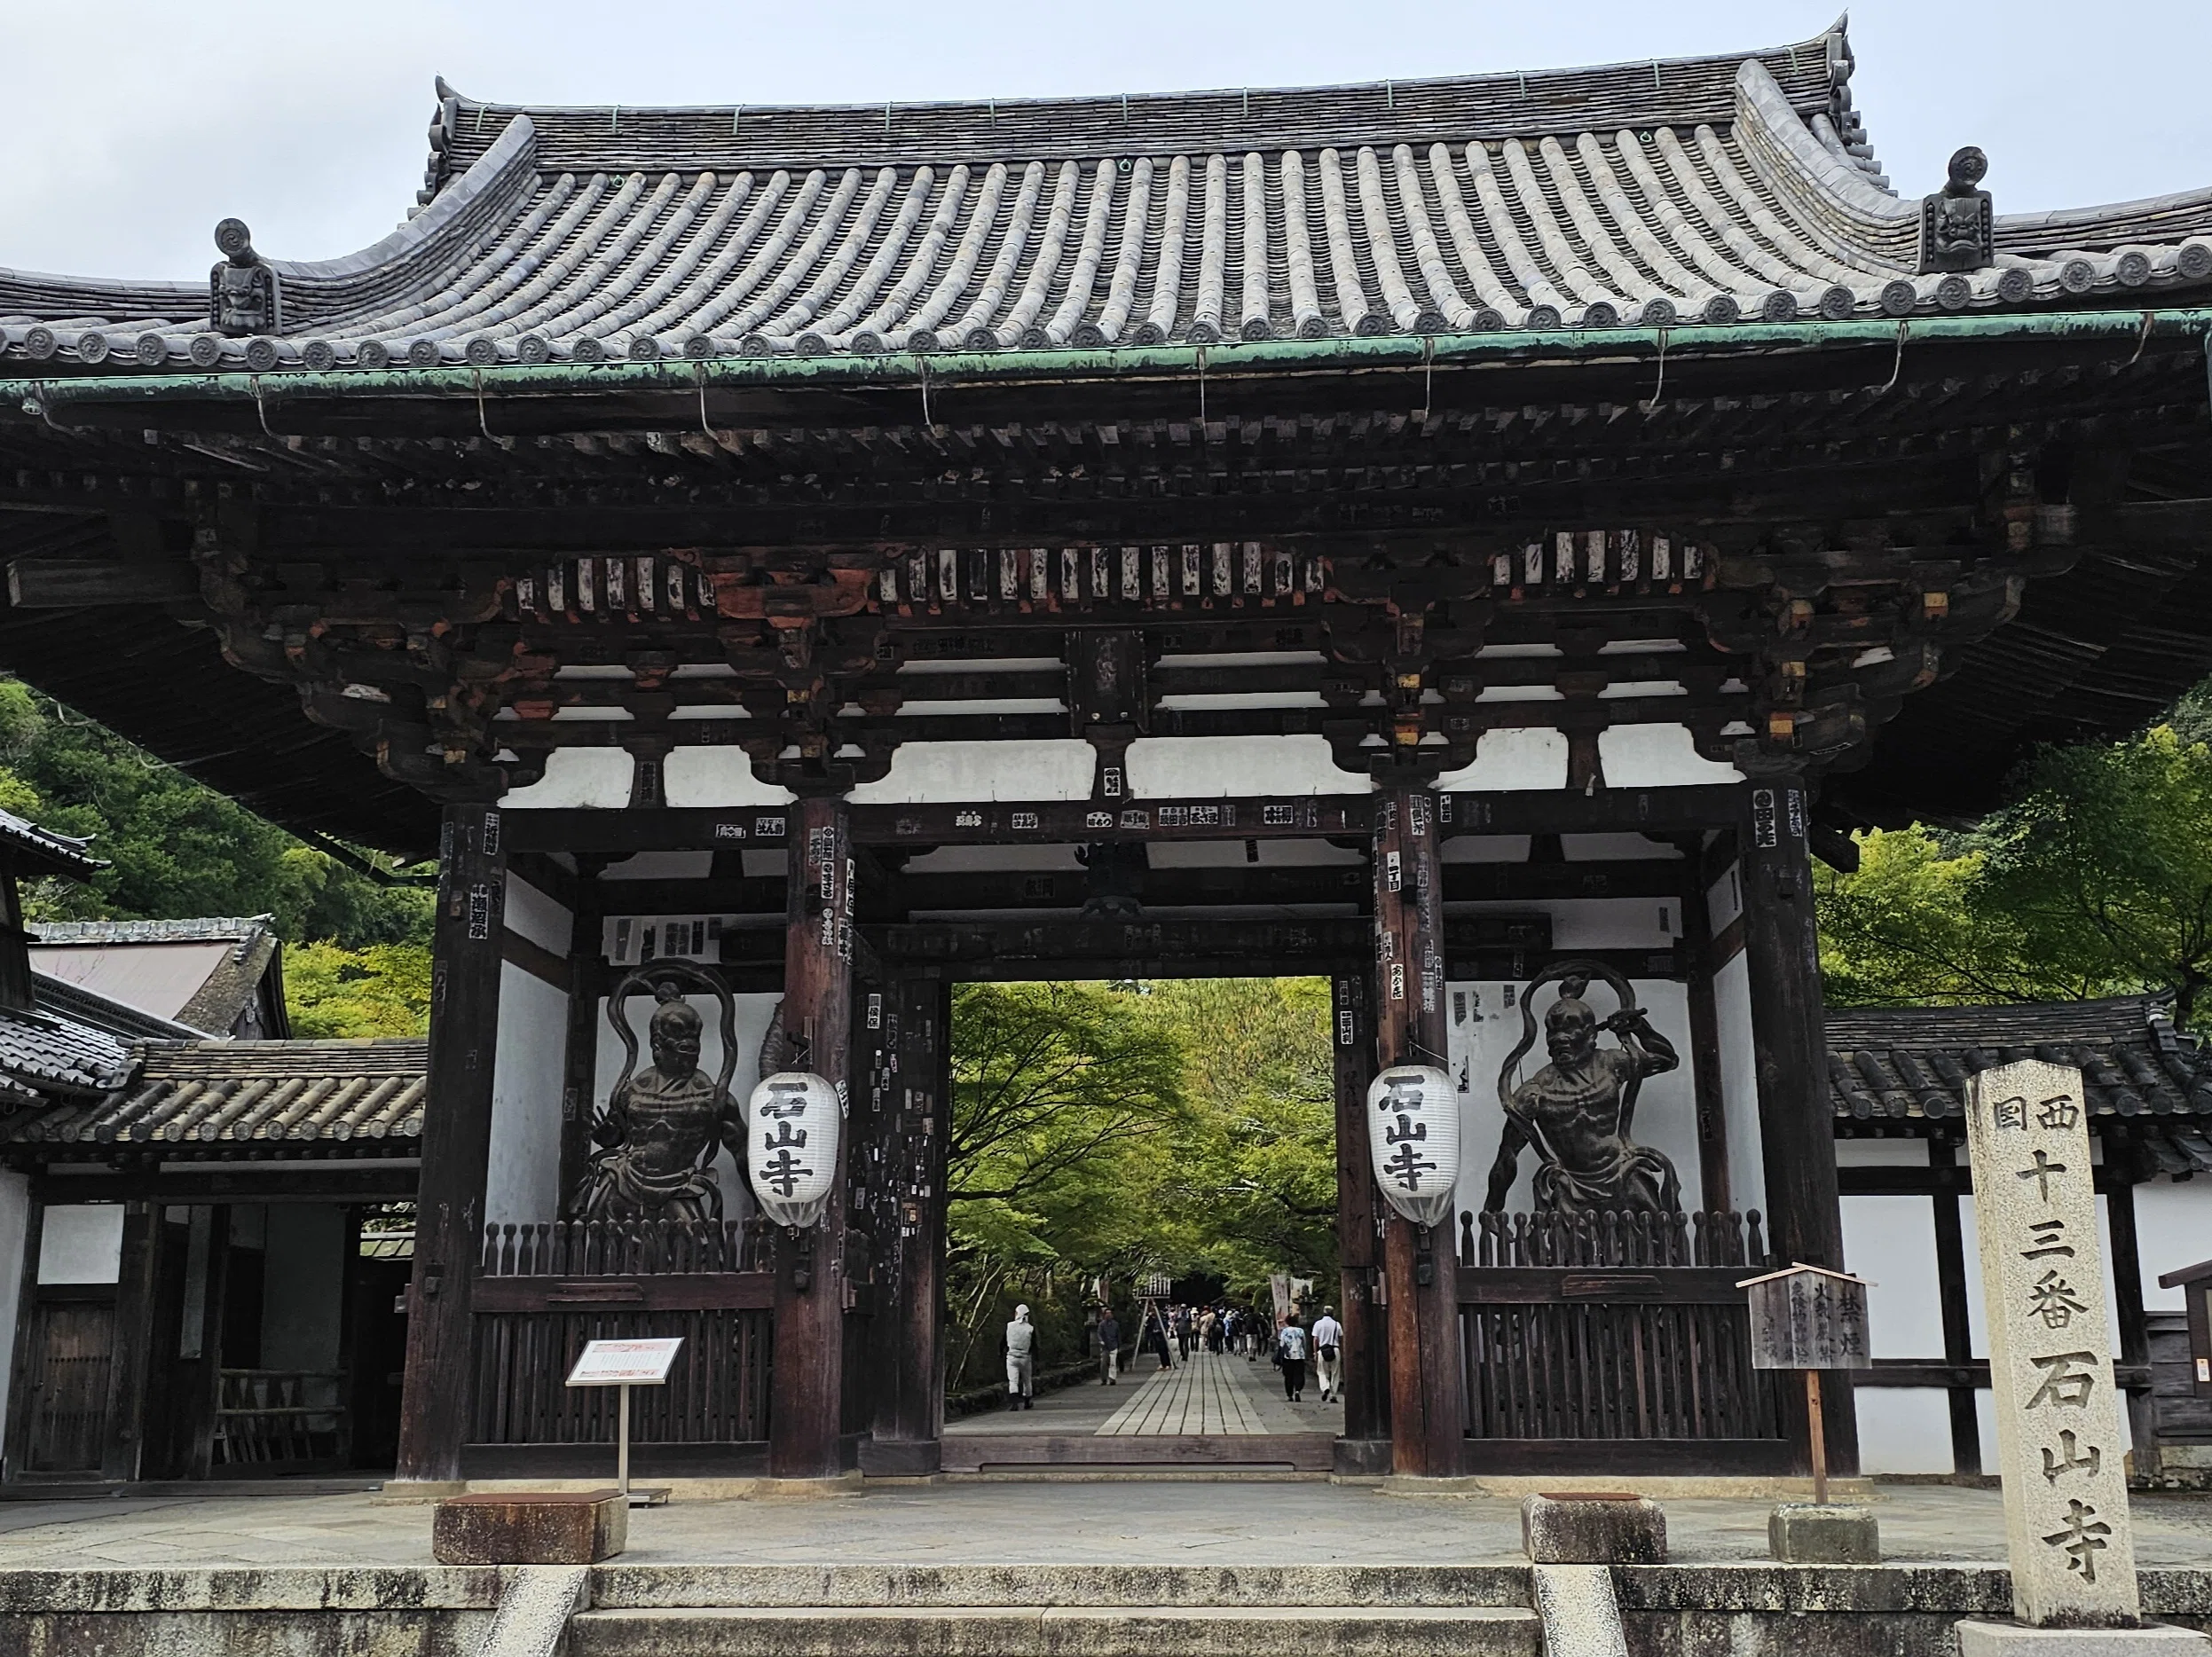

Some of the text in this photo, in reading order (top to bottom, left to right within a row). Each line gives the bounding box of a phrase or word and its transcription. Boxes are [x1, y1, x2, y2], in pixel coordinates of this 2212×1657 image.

[760, 1081, 814, 1198] 石山寺
[1379, 1074, 1437, 1191] 石山寺
[2016, 1150, 2113, 1585] 十三番石山寺
